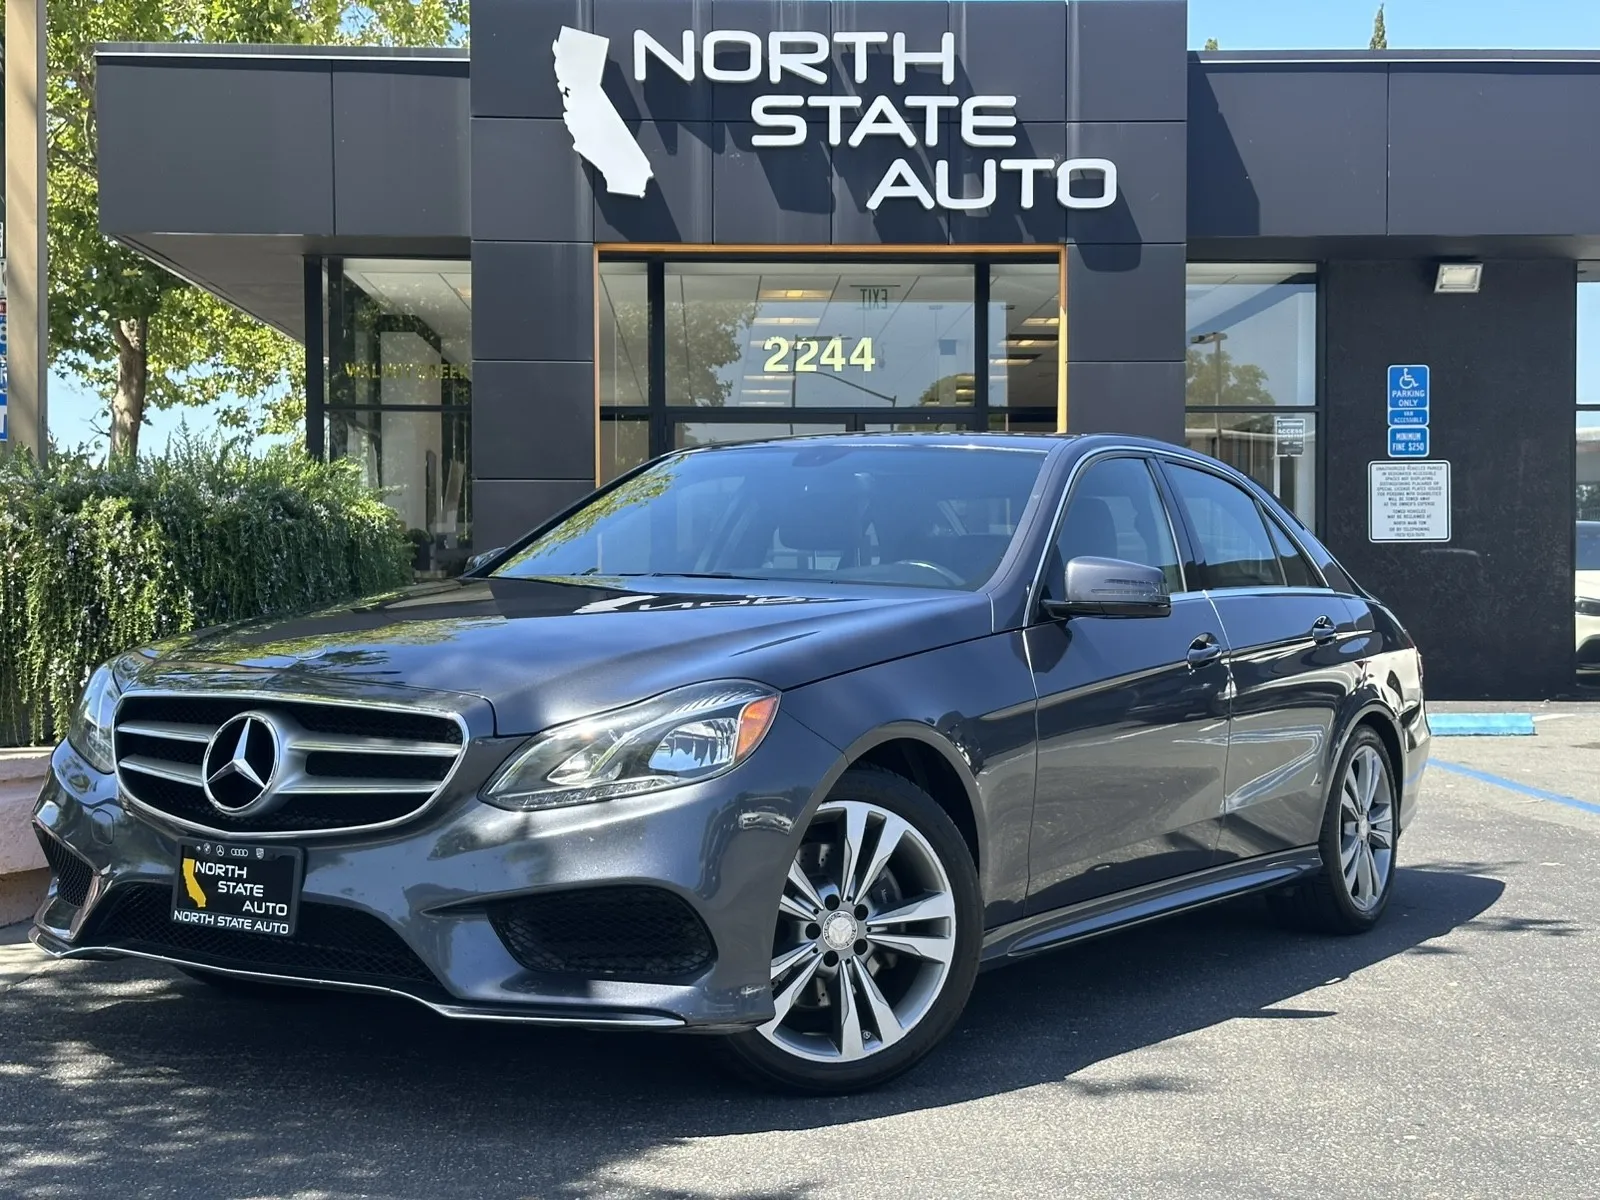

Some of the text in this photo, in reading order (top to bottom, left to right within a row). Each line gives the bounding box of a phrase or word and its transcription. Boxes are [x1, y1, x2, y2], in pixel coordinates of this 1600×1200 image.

[633, 29, 955, 84] NORTH
[751, 95, 1017, 147] STATE
[866, 158, 1117, 210] AUTO
[763, 336, 875, 372] 2244
[1396, 432, 1421, 440] MINIMUM
[1392, 443, 1424, 451] FINE $250
[195, 861, 247, 878] NORTH
[218, 881, 264, 897] STATE
[242, 900, 288, 916] AUTO
[174, 910, 289, 934] NORTH STATE AUTO
